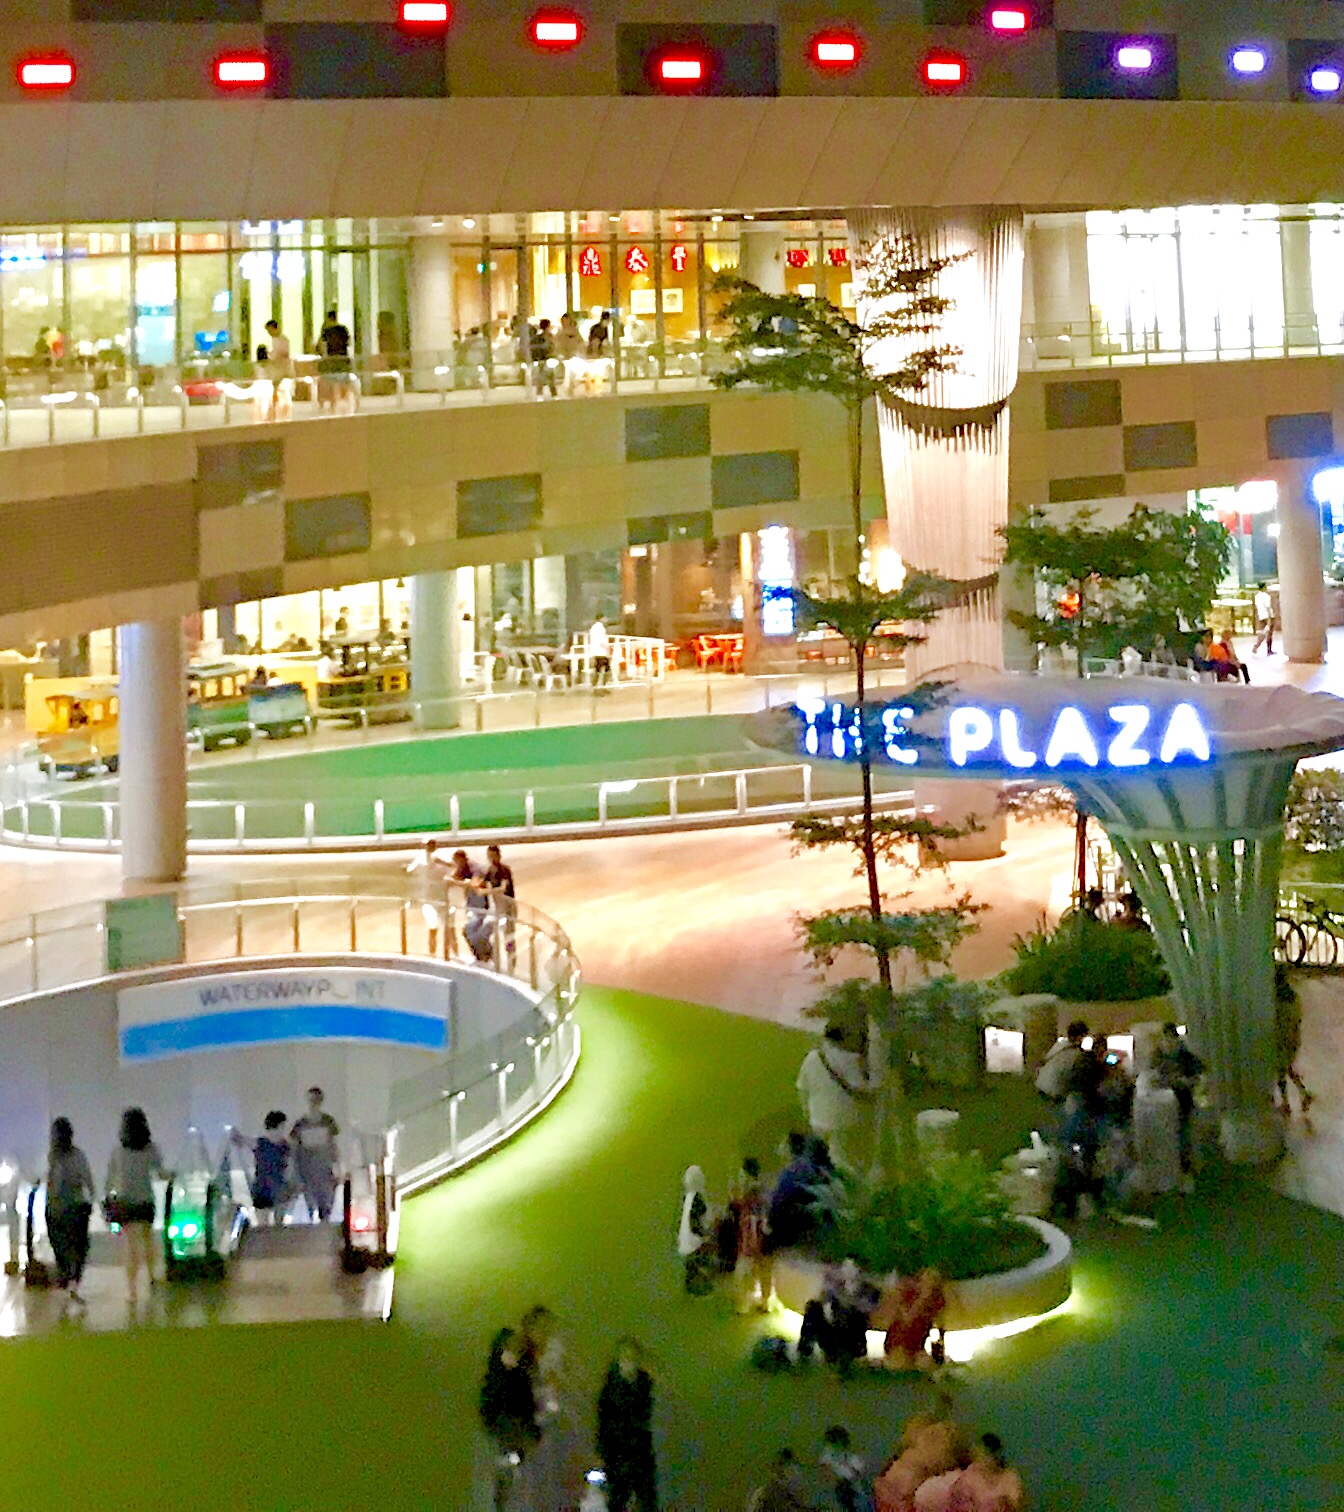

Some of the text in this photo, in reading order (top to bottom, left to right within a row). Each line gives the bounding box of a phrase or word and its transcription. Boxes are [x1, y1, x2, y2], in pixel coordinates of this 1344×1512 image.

[795, 694, 1210, 767] THE PLAZA
[199, 977, 385, 1005] WATERWAYPINT
